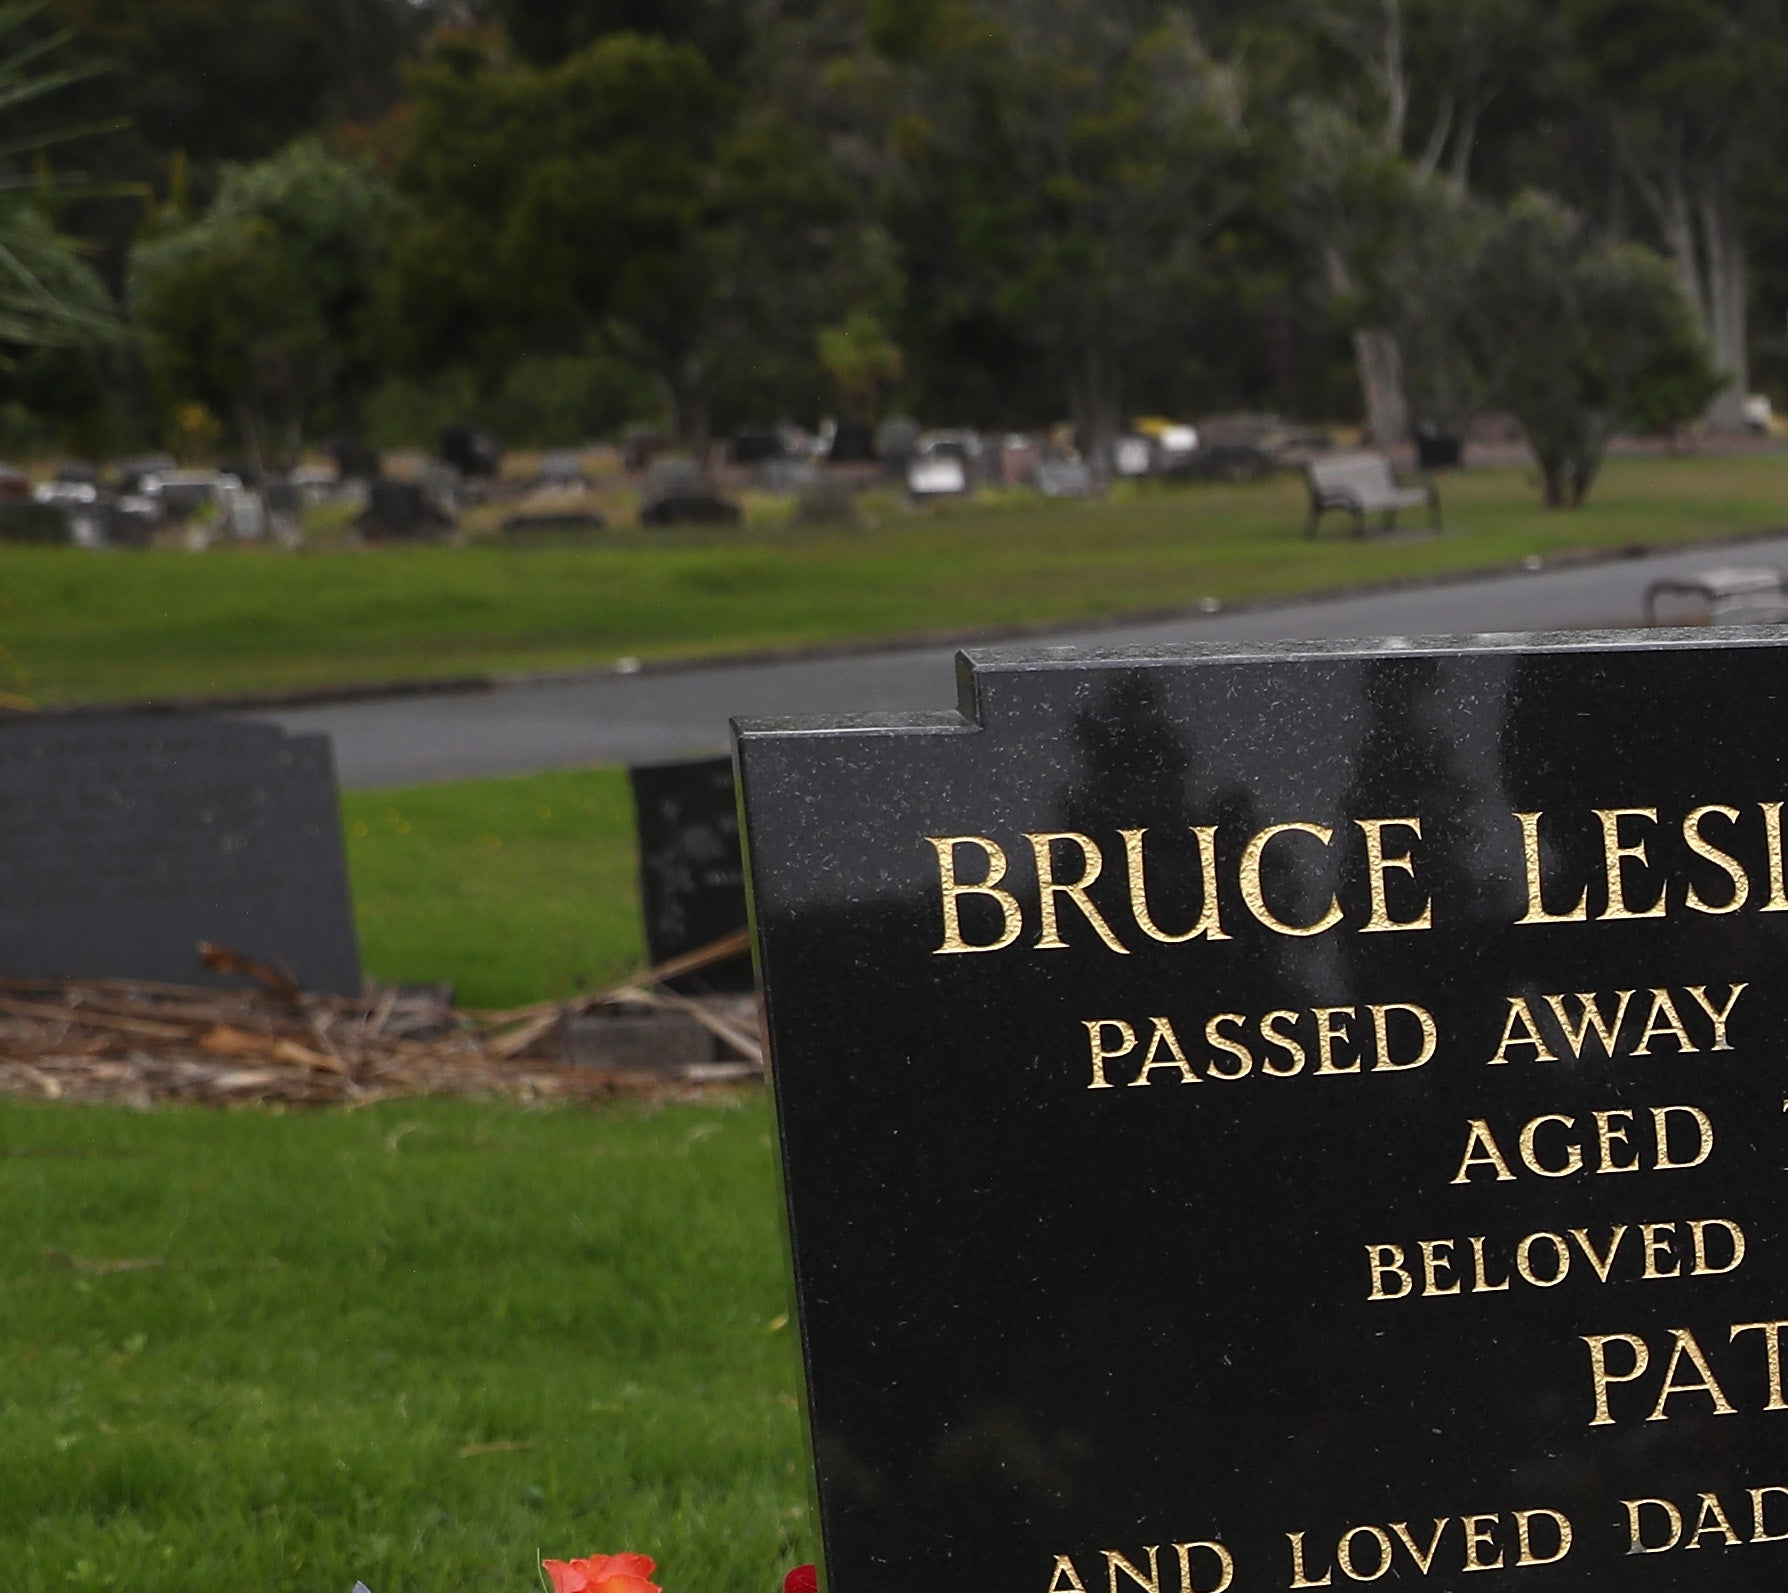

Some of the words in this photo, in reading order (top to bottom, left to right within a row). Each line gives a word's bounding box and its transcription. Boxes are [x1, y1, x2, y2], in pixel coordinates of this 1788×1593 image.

[924, 818, 1431, 954] BRUCE
[1081, 1004, 1437, 1088] PASSED
[1487, 983, 1748, 1064] AWAY
[1450, 1106, 1713, 1184] AGED
[1365, 1219, 1745, 1300] BELOVED
[1286, 1510, 1572, 1588] LOVED
